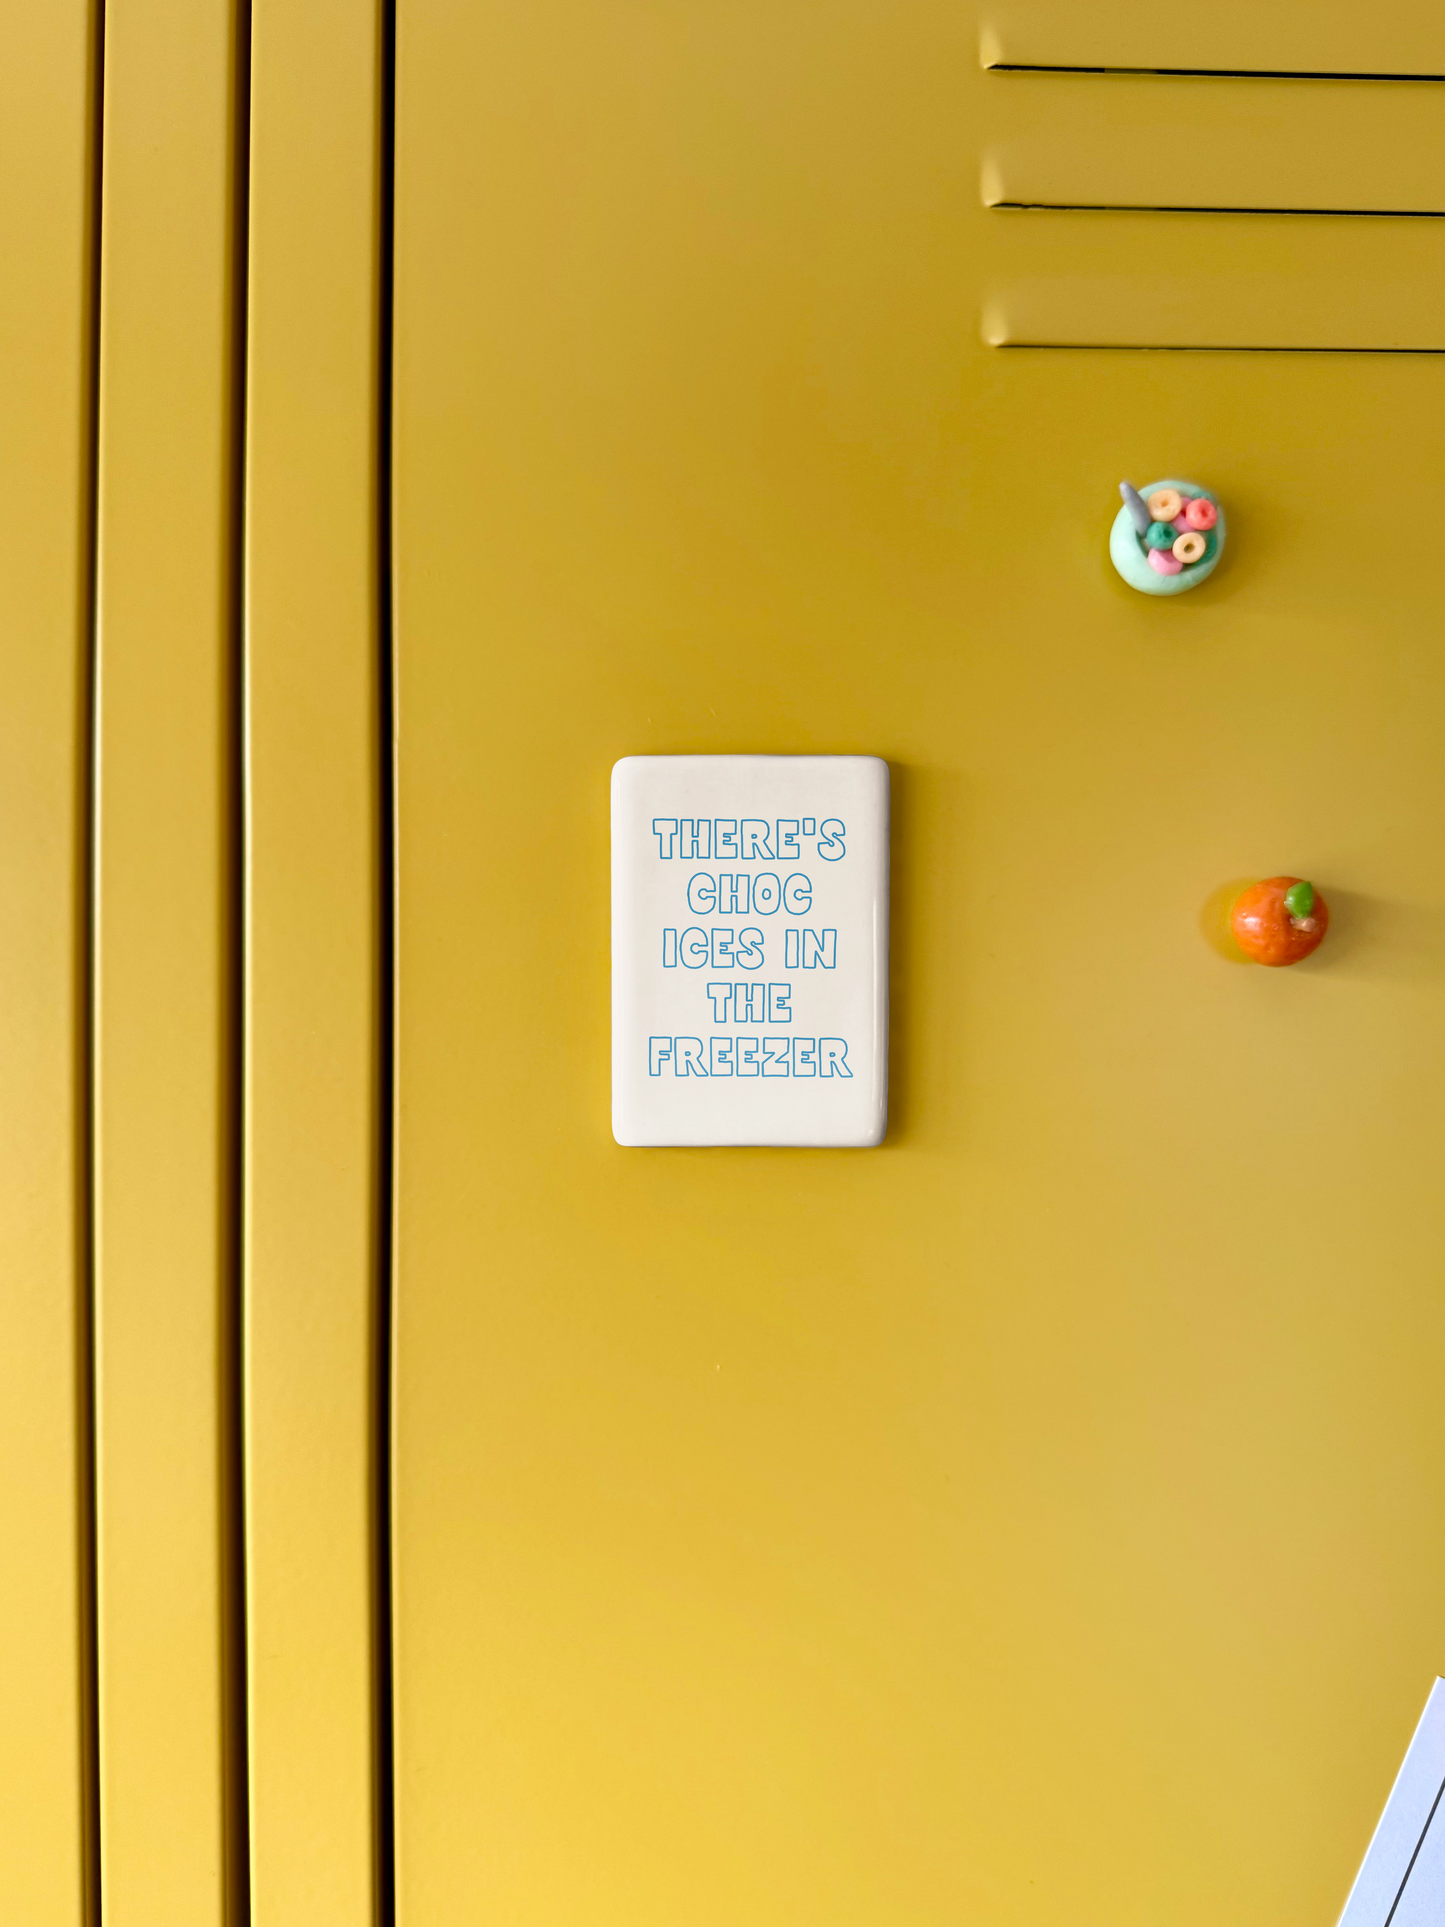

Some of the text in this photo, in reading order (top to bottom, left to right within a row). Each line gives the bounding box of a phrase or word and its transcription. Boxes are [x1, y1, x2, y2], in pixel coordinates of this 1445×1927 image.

[652, 817, 847, 861] THERE'S
[686, 872, 813, 915] CHOC
[662, 926, 837, 970] ICES IN
[706, 982, 792, 1023] THE
[648, 1036, 854, 1078] FREEZER
